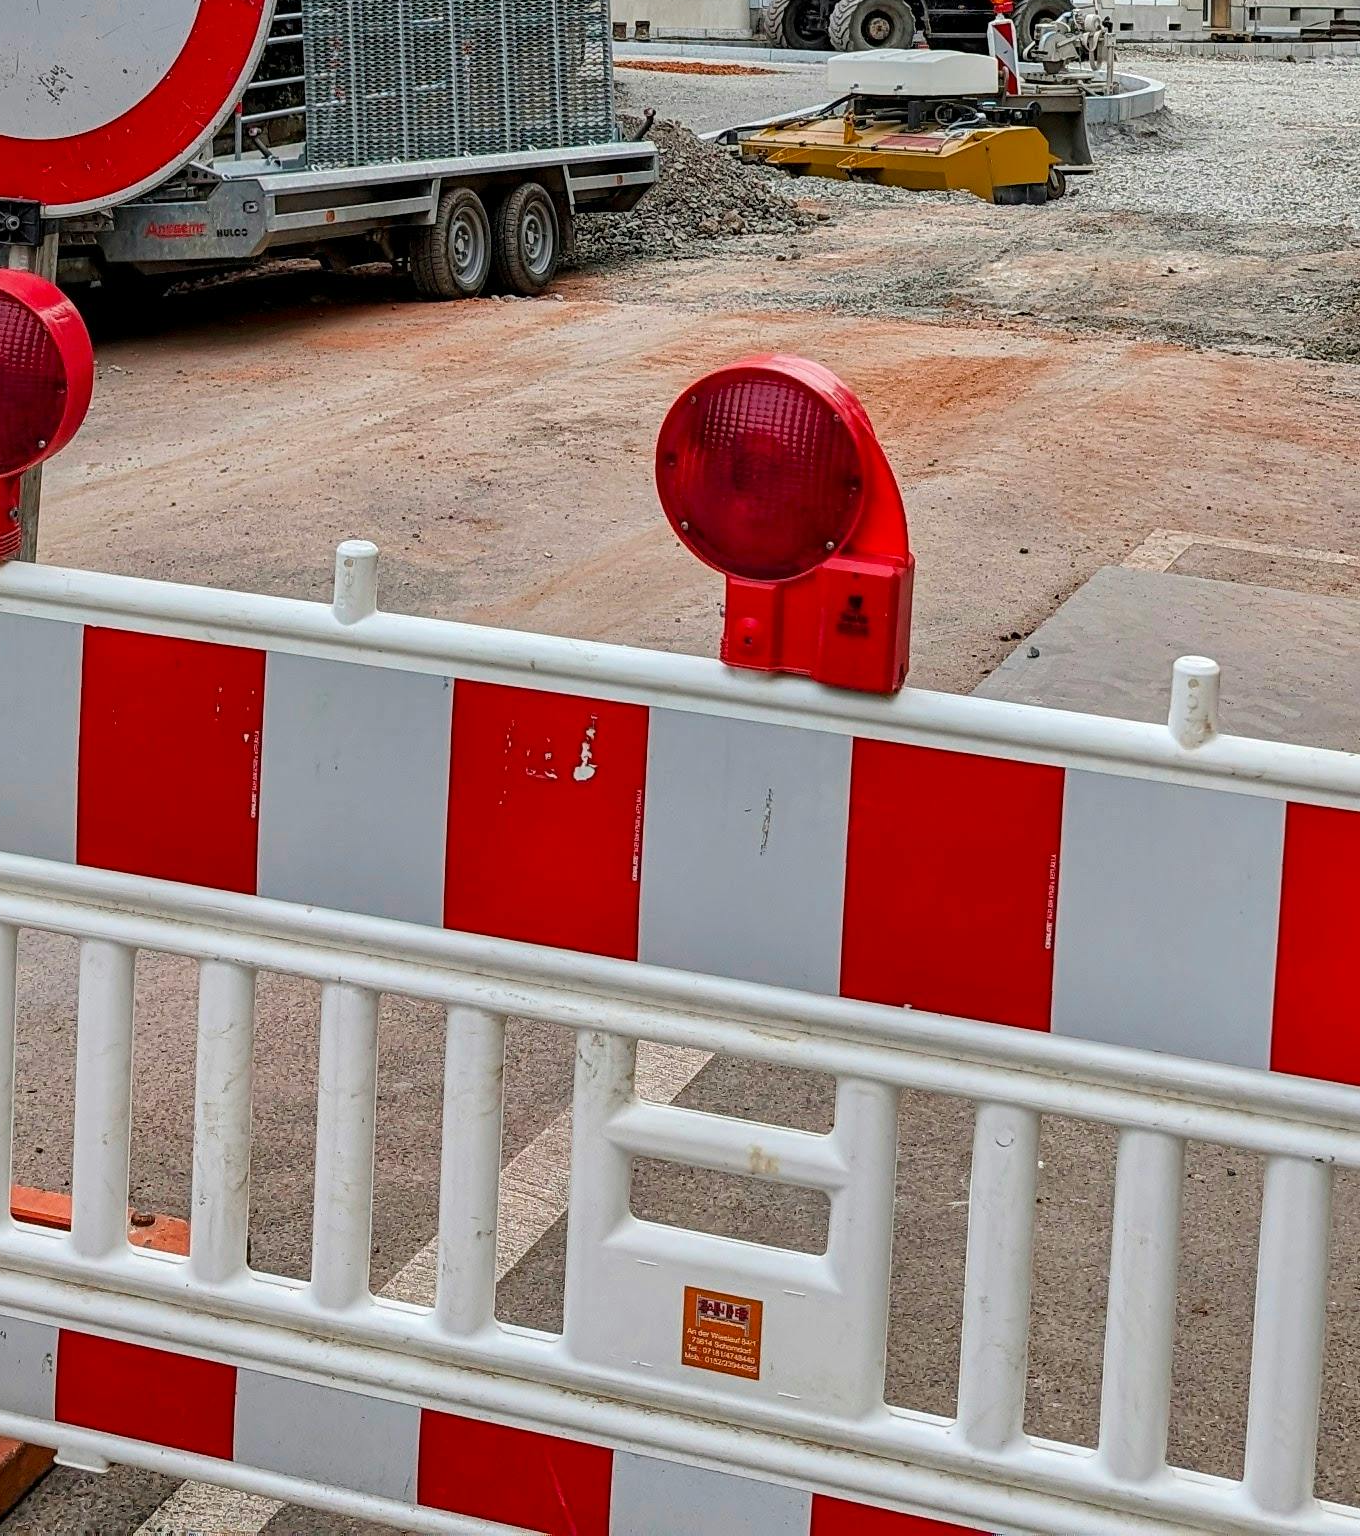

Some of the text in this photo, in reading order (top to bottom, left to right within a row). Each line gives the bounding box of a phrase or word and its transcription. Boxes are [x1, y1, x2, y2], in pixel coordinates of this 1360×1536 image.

[687, 1328, 697, 1336] An
[698, 1329, 710, 1338] der
[714, 1341, 752, 1354] Schorndorf
